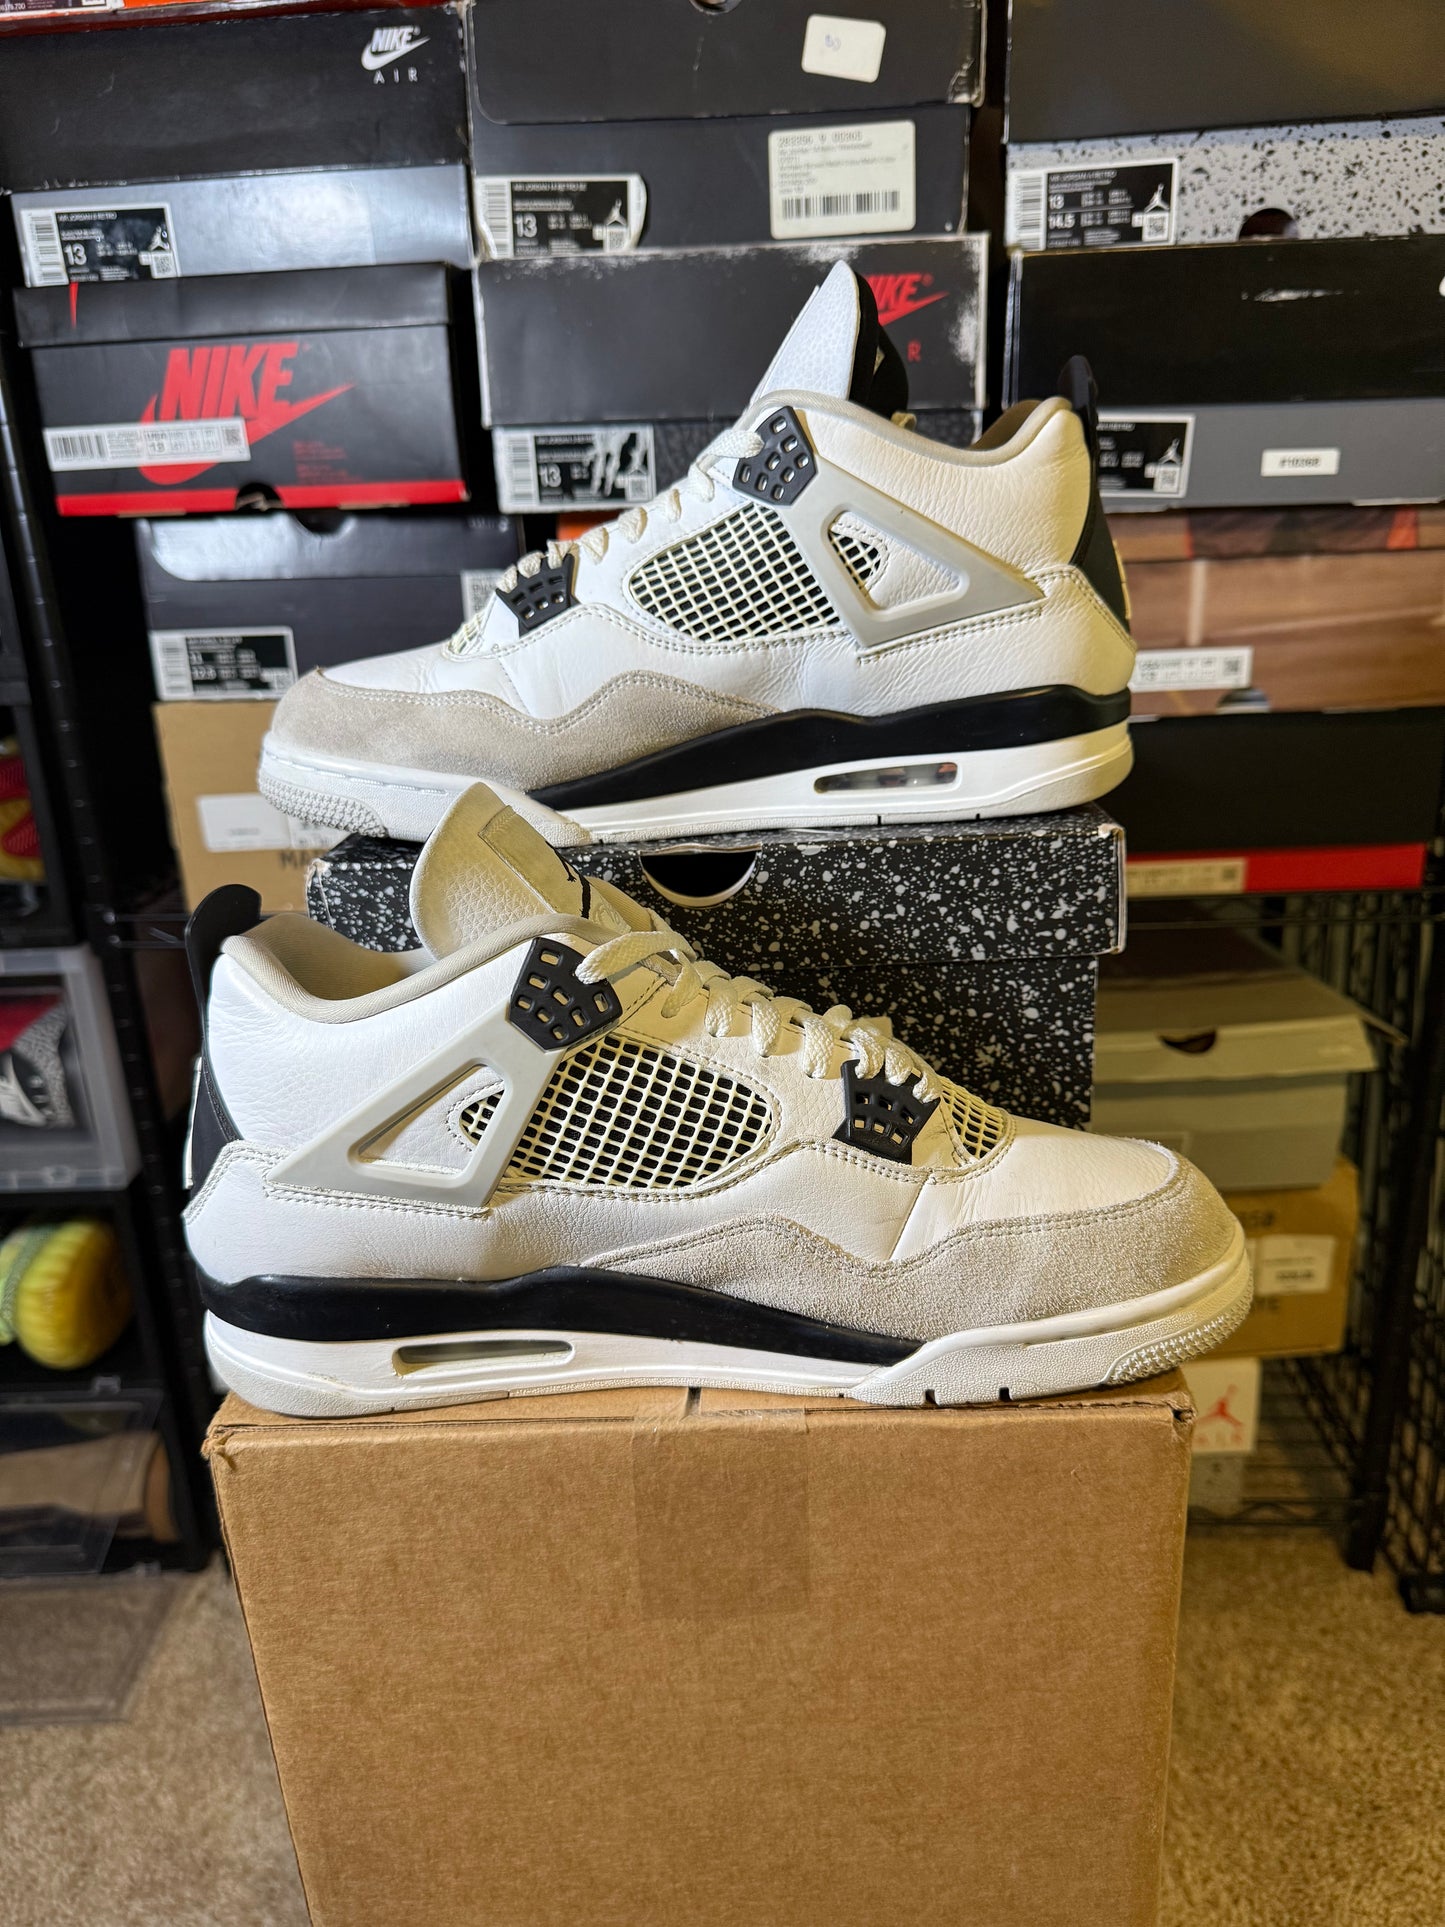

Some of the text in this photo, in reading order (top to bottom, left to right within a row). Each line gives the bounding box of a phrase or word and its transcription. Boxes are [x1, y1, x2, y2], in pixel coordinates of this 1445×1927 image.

[371, 25, 414, 52] NIKE
[373, 67, 418, 84] AIR
[514, 213, 538, 238] 13
[64, 243, 88, 266] 13
[158, 342, 298, 421] NIKE
[538, 463, 562, 488] 13
